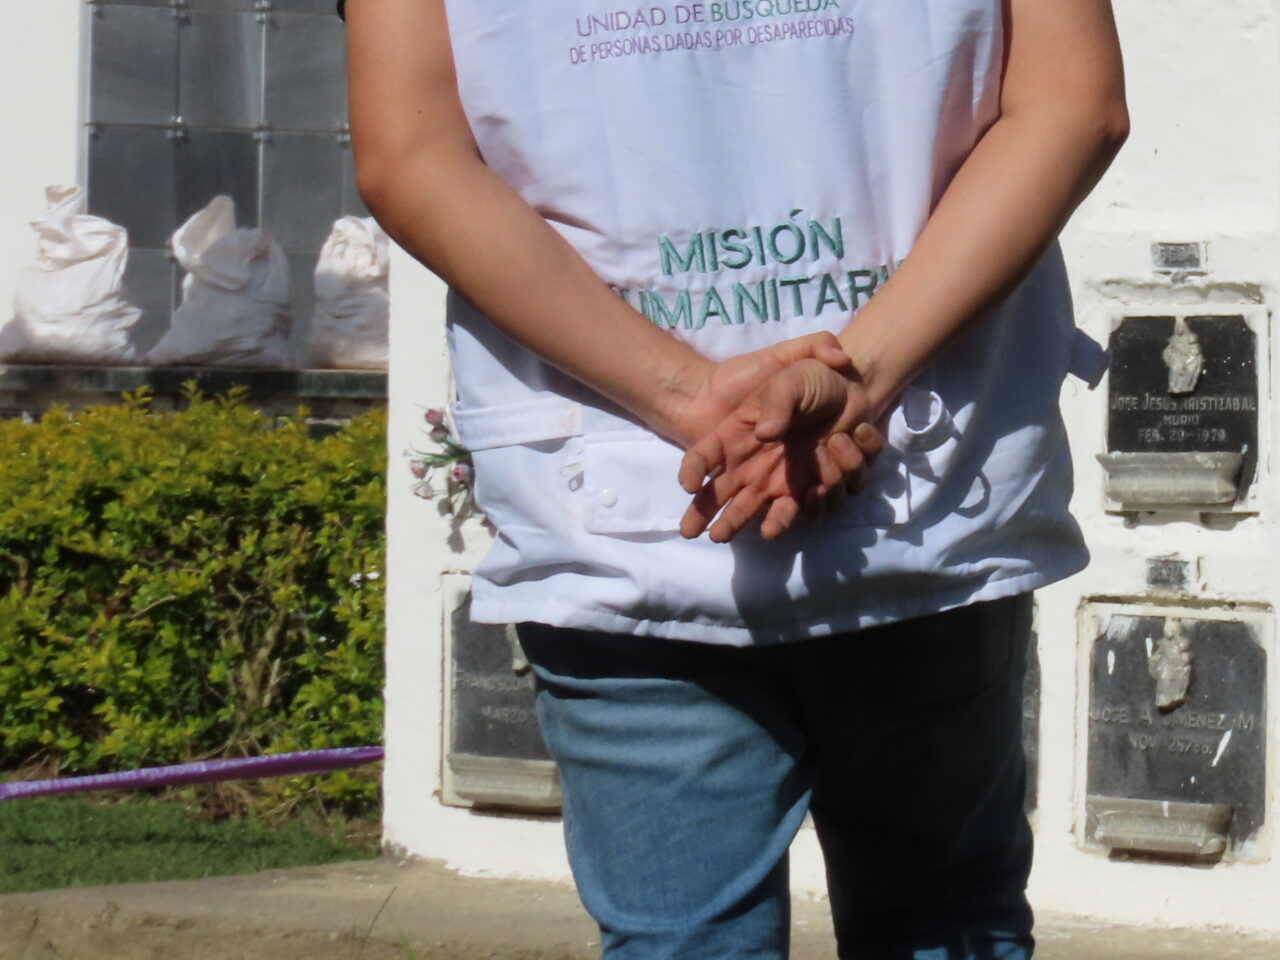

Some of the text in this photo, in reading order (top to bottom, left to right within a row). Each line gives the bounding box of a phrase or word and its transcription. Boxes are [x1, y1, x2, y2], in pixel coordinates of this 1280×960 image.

[569, 16, 856, 65] DE PERSONAS DADAS POR DESAPARECIDAS
[575, 7, 667, 38] UNIDAD
[674, 3, 706, 25] DE
[658, 209, 845, 277] MISIÓN
[619, 259, 904, 331] MANITAR
[1111, 392, 1138, 411] JOSE
[1143, 392, 1178, 412] JESUS
